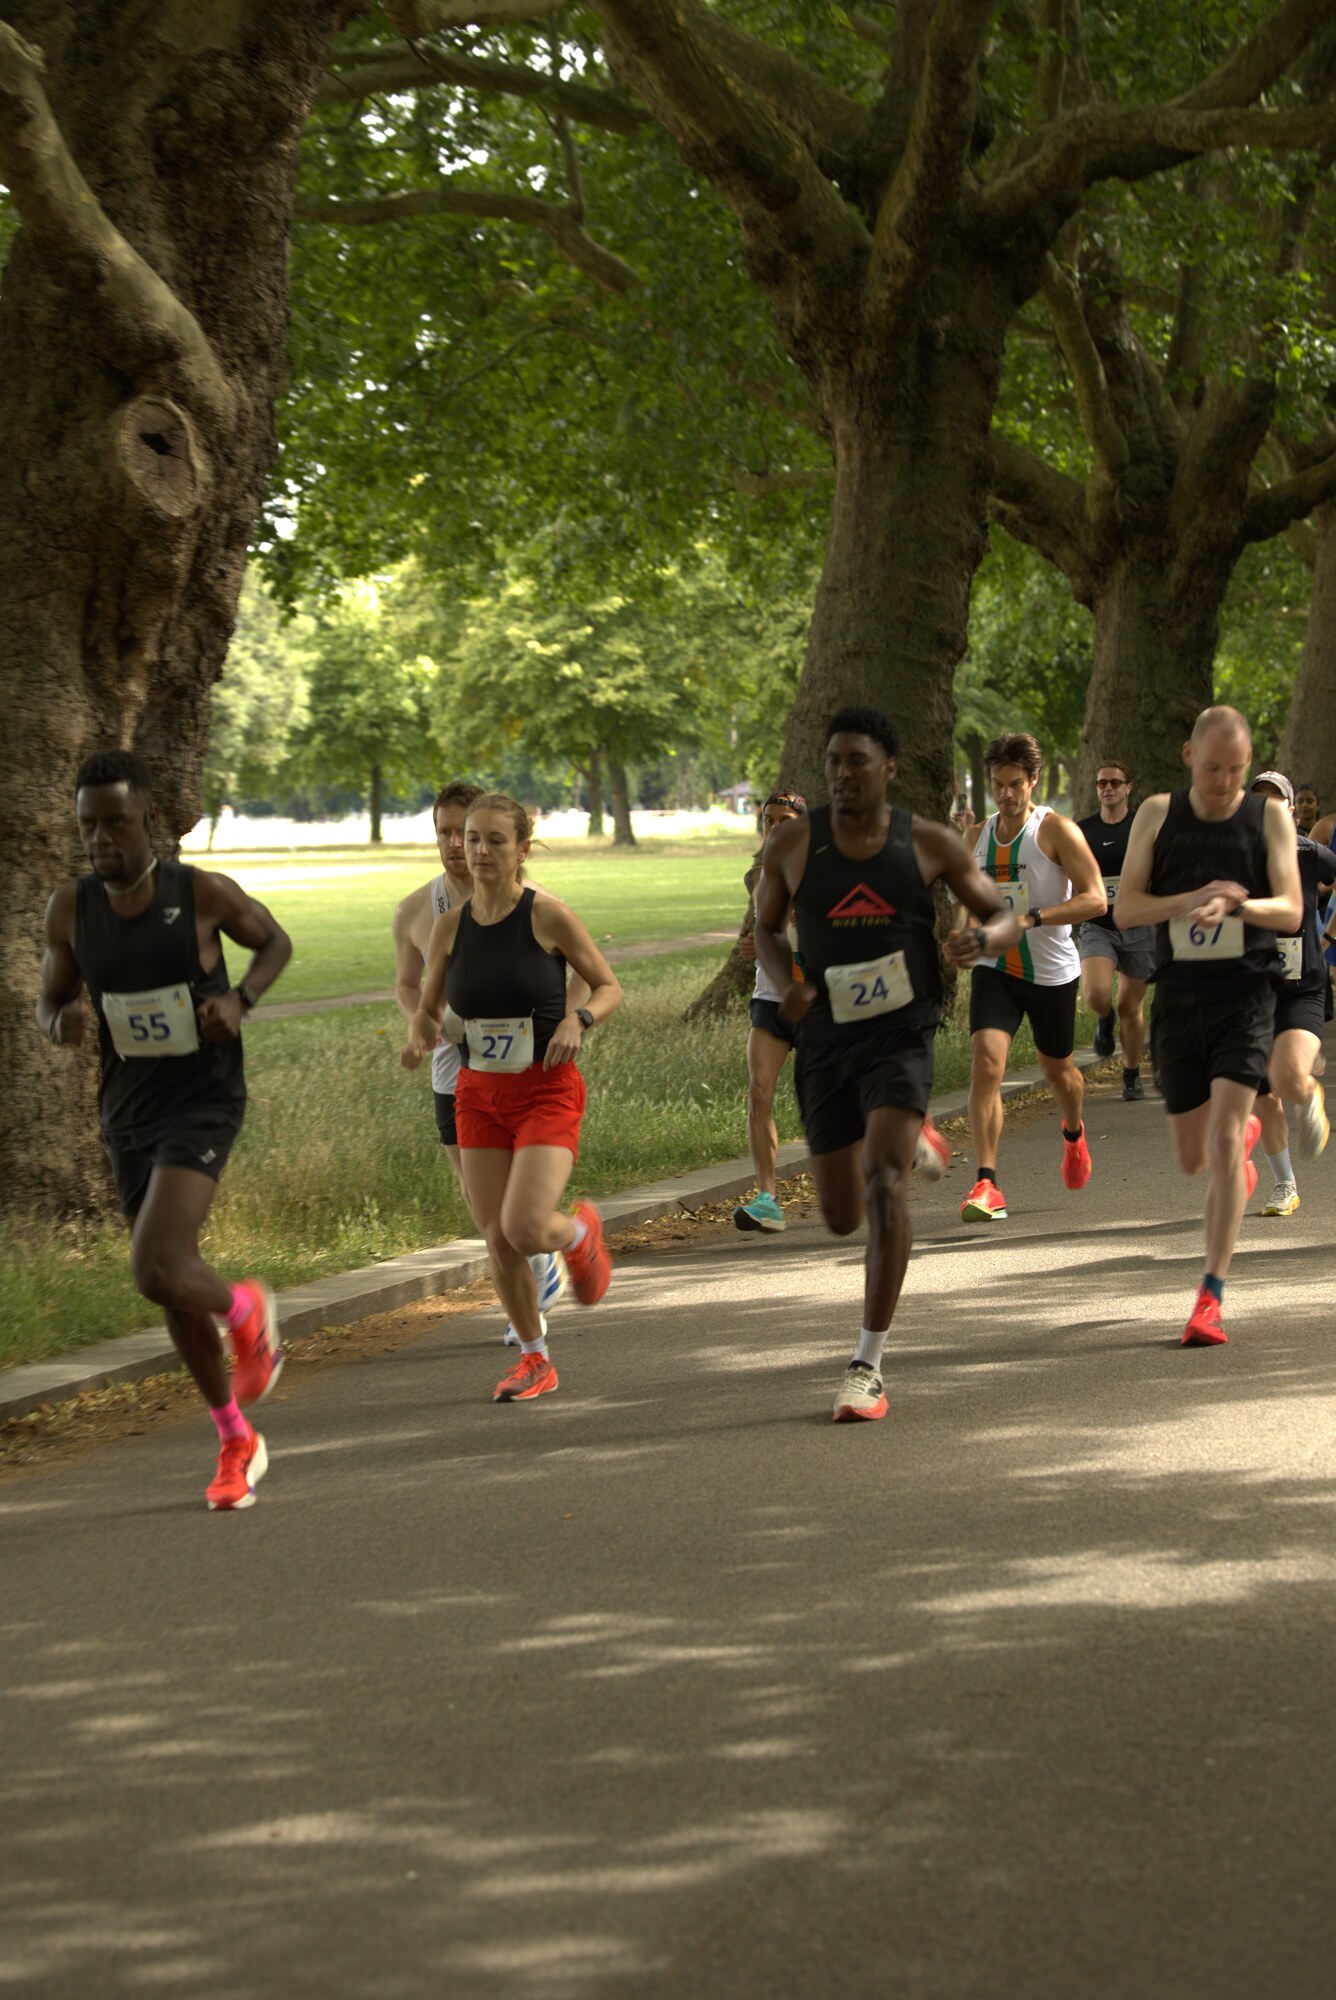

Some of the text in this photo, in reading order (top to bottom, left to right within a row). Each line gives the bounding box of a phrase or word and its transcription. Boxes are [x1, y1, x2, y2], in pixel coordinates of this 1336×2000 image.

[850, 975, 889, 1007] 24
[128, 1012, 171, 1041] 55
[482, 1035, 514, 1060] 27
